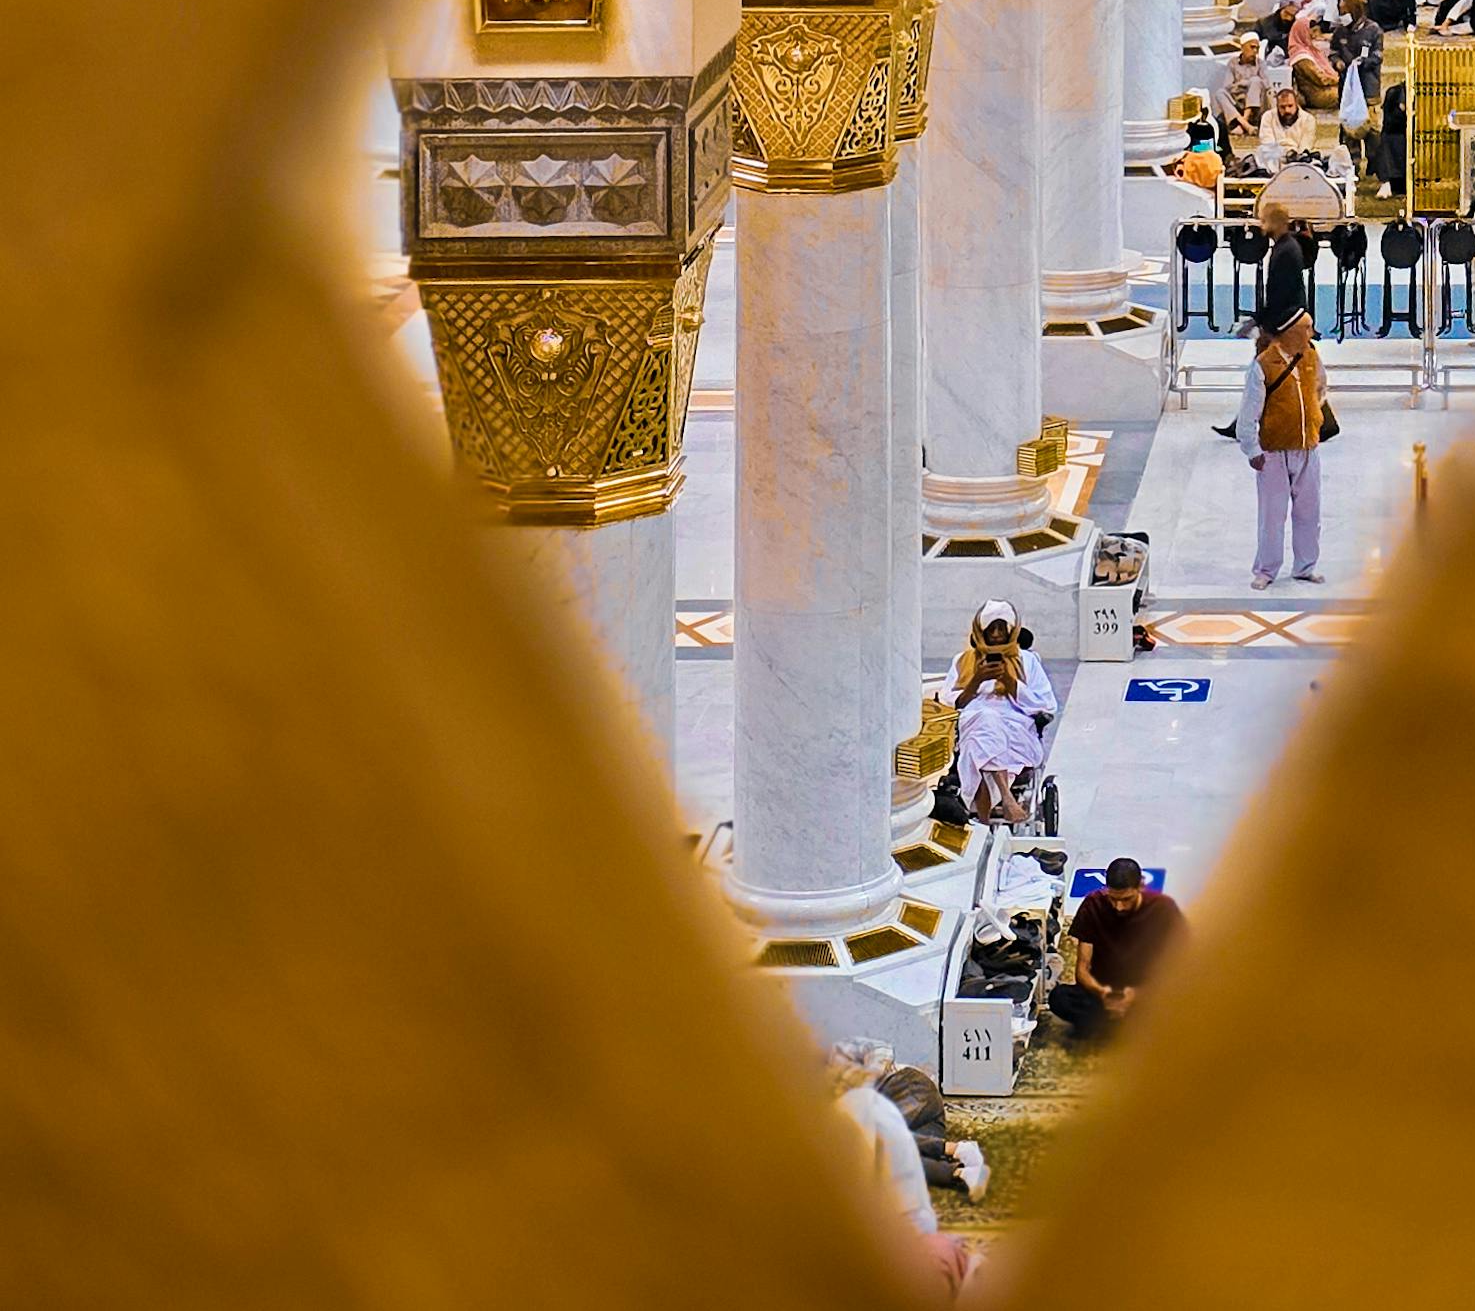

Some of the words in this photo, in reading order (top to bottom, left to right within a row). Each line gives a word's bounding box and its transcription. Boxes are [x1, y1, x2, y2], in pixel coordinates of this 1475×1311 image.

[1093, 608, 1117, 620] ٣٩٩
[1093, 622, 1119, 635] 399
[963, 1028, 992, 1042] ٤١١
[962, 1046, 992, 1061] 411
